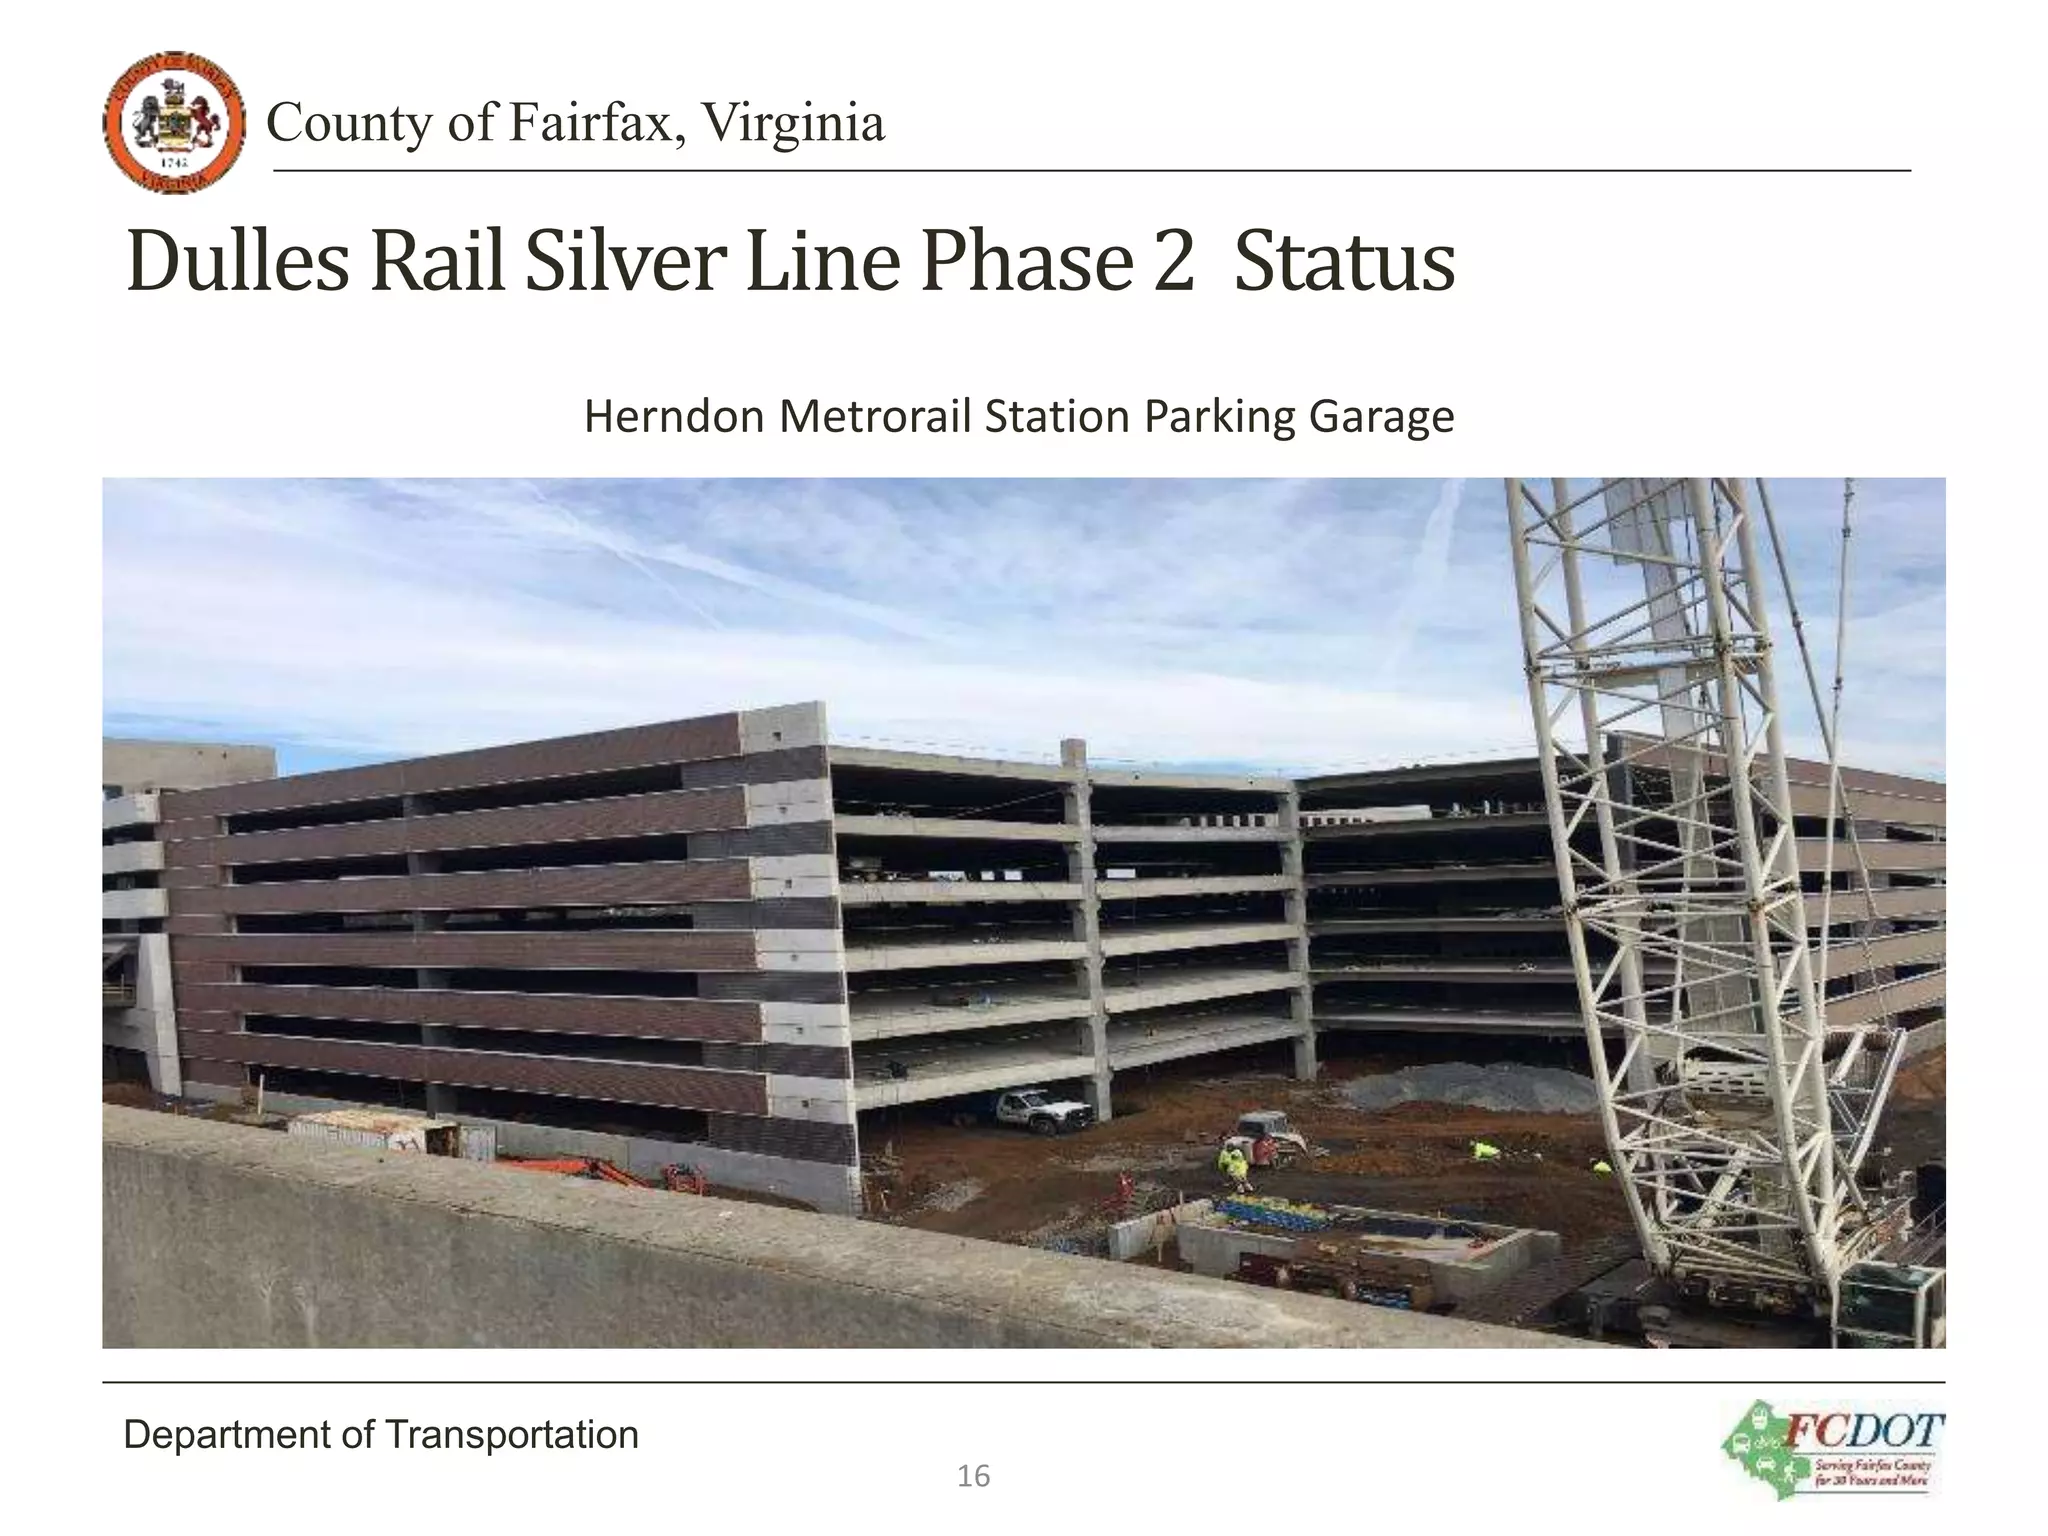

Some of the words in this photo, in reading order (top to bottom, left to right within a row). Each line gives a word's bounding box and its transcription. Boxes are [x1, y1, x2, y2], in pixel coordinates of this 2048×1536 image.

[160, 157, 189, 168] 1742
[1781, 1413, 1947, 1448] FCDOT
[1815, 1458, 1853, 1473] Serving
[1855, 1458, 1892, 1473] Fairfax
[1894, 1458, 1932, 1474] County
[1815, 1474, 1831, 1488] for
[1849, 1475, 1877, 1486] Years
[1878, 1474, 1899, 1486] and
[1900, 1474, 1929, 1486] More
